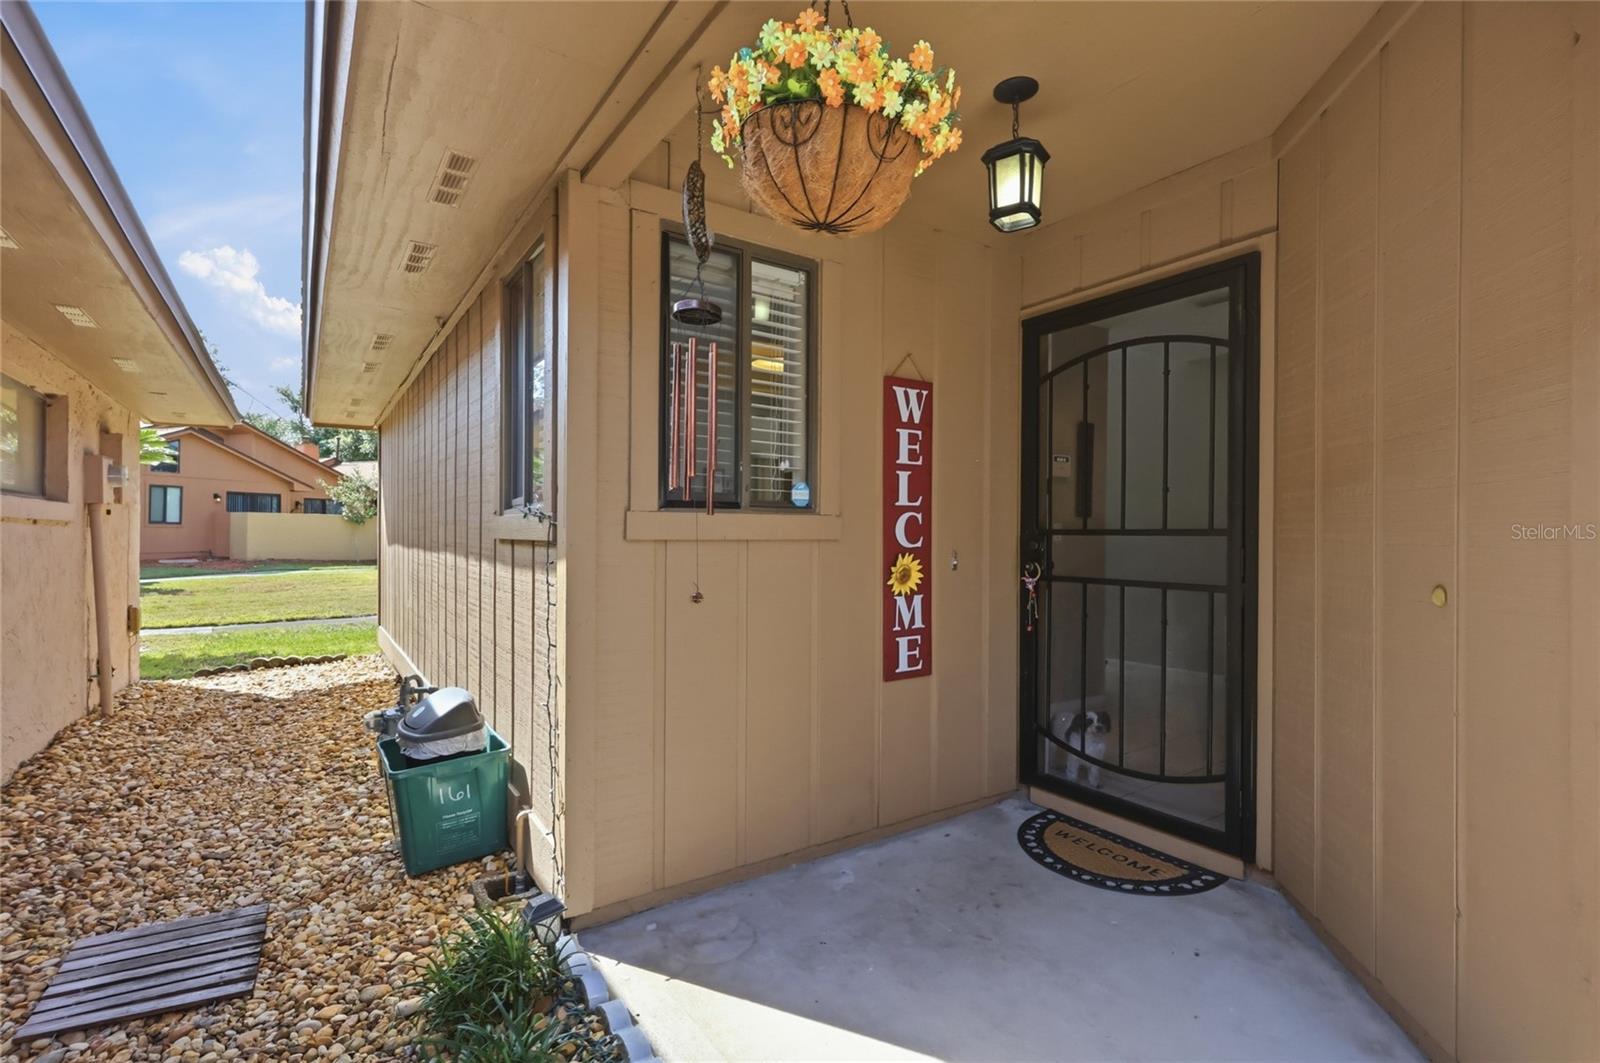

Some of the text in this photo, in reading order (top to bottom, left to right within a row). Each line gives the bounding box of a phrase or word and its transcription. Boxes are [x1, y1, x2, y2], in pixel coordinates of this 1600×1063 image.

[892, 385, 929, 674] WELCME
[439, 783, 471, 804] 161
[1054, 829, 1167, 877] WELCOME
